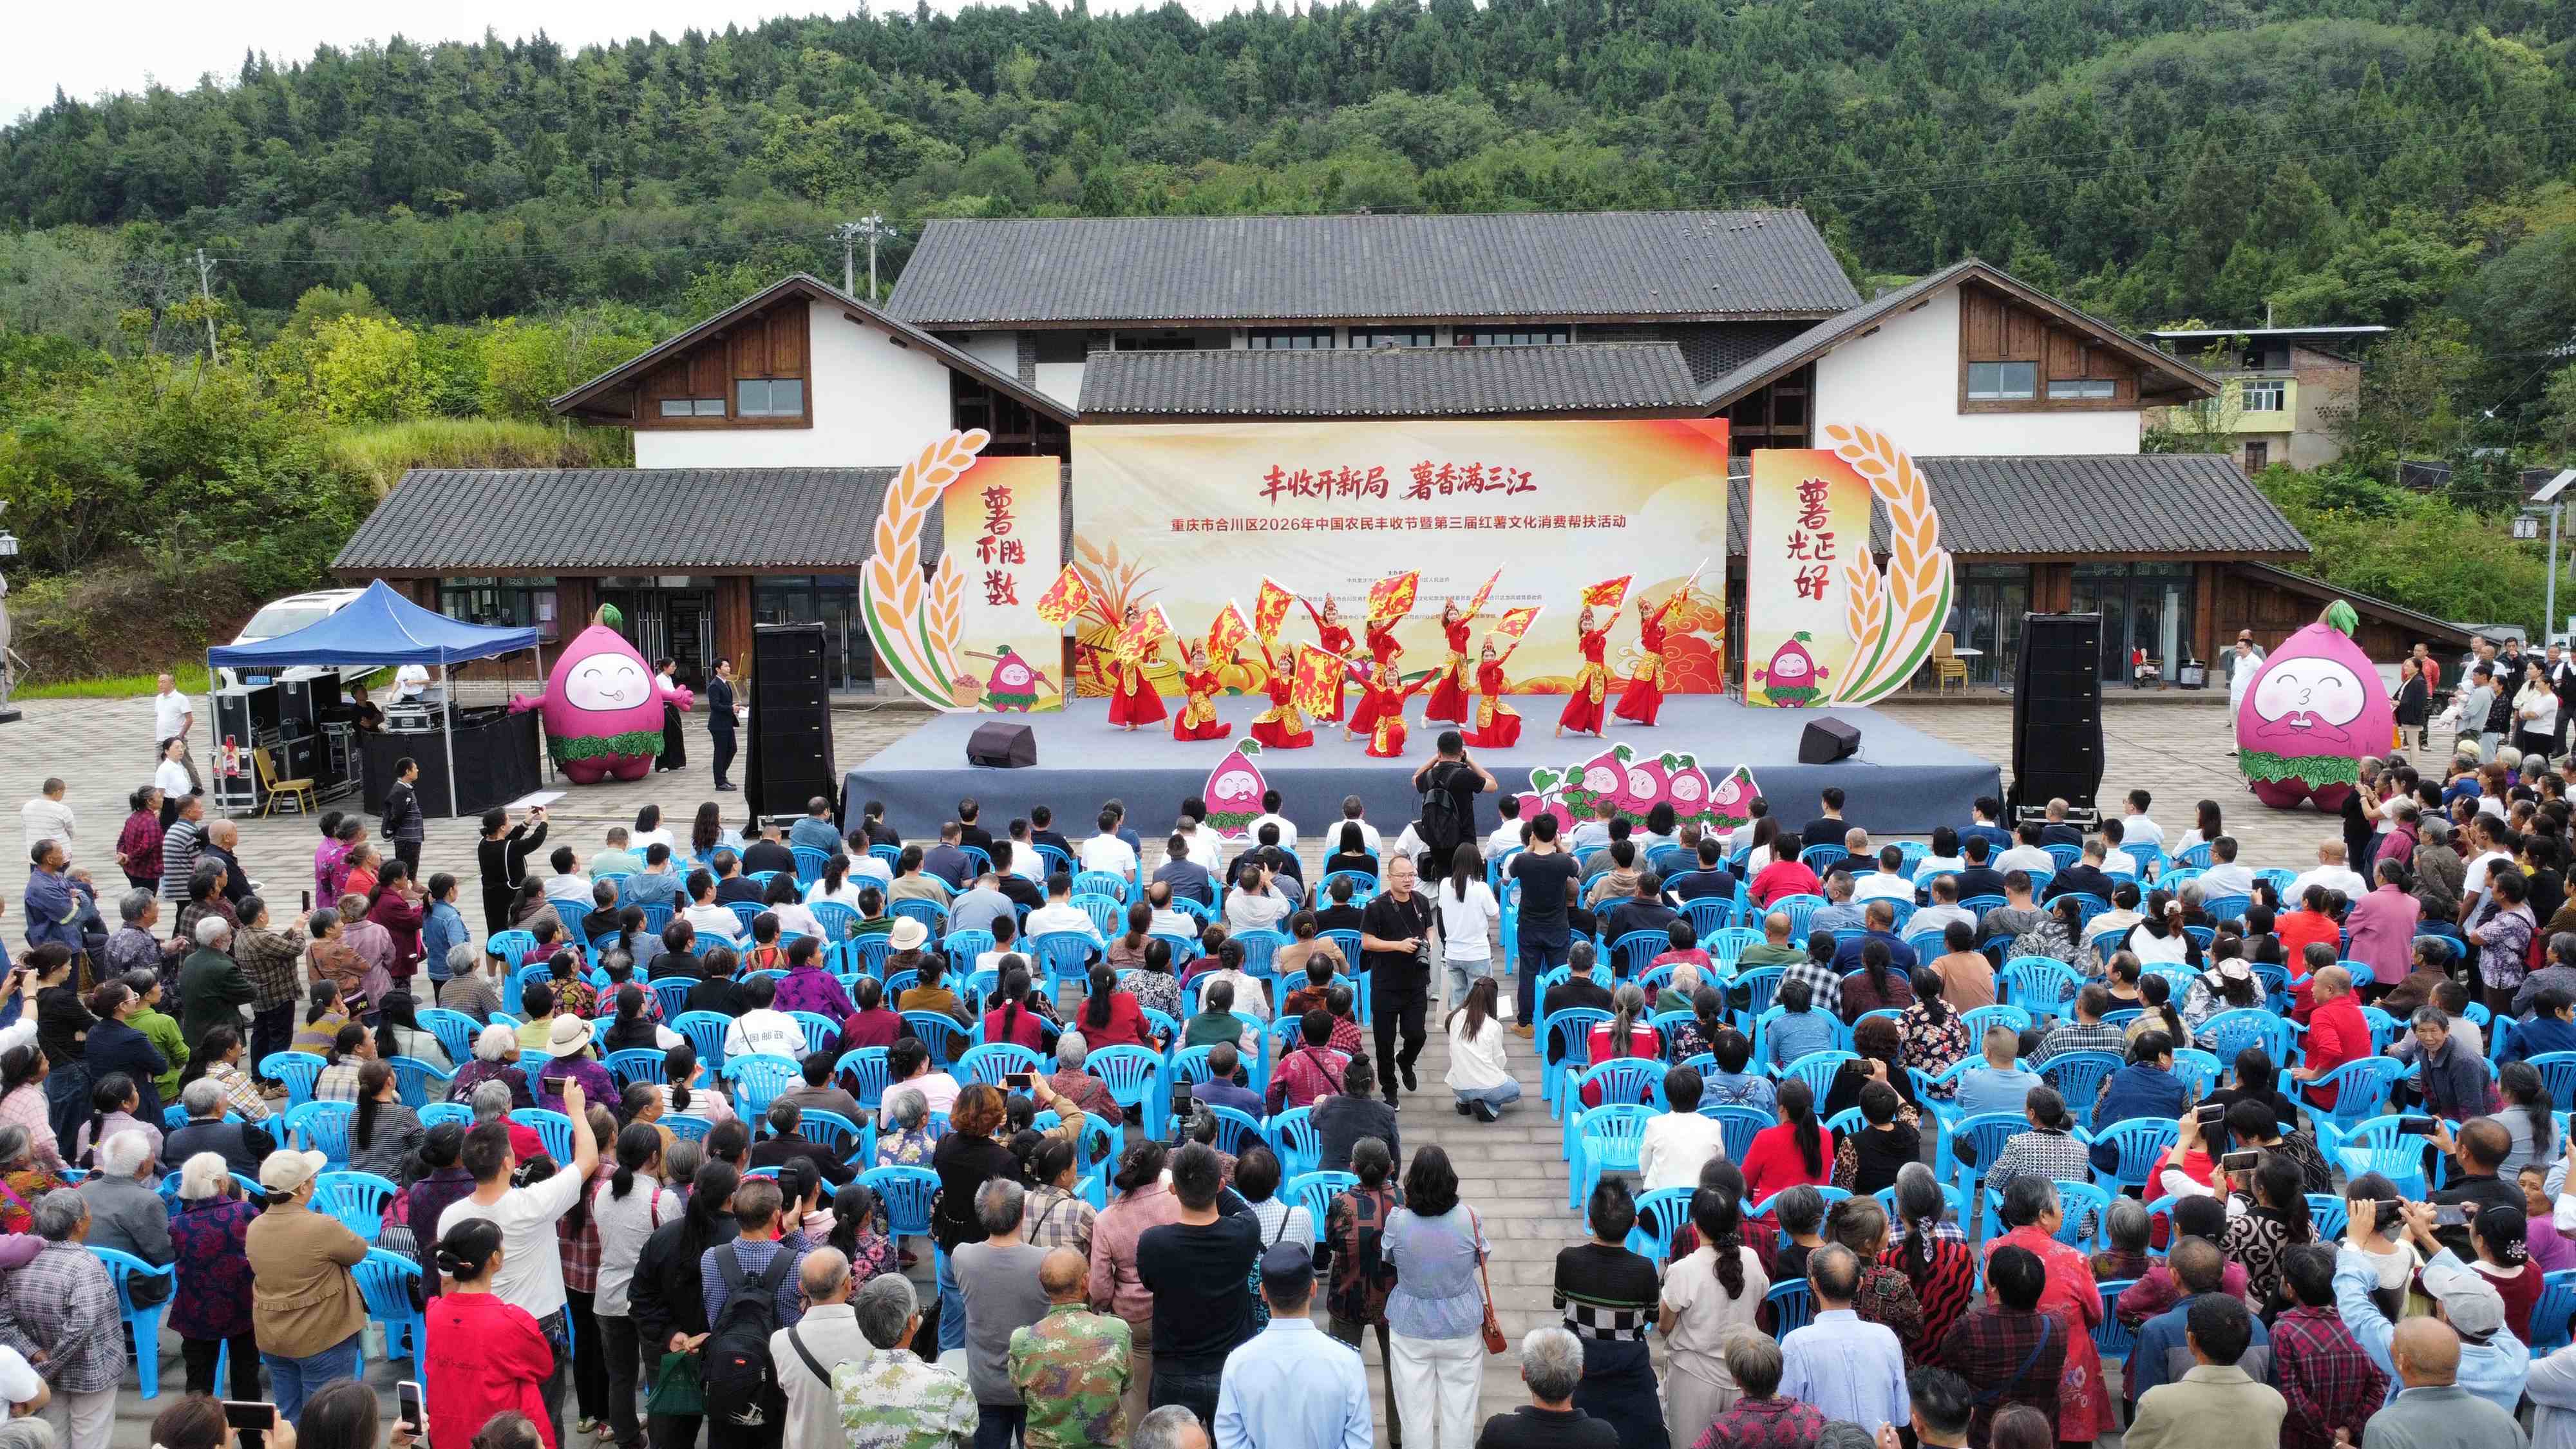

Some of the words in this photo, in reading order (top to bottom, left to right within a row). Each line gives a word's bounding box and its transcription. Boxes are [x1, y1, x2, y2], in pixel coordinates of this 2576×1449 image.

[1259, 464, 1389, 507] 丰收开新局
[1399, 460, 1537, 500] 薯香满三江
[1171, 515, 1627, 532] 重庆市合川区2026年中国农民丰收节暨第三届红薯文化消费帮扶活动
